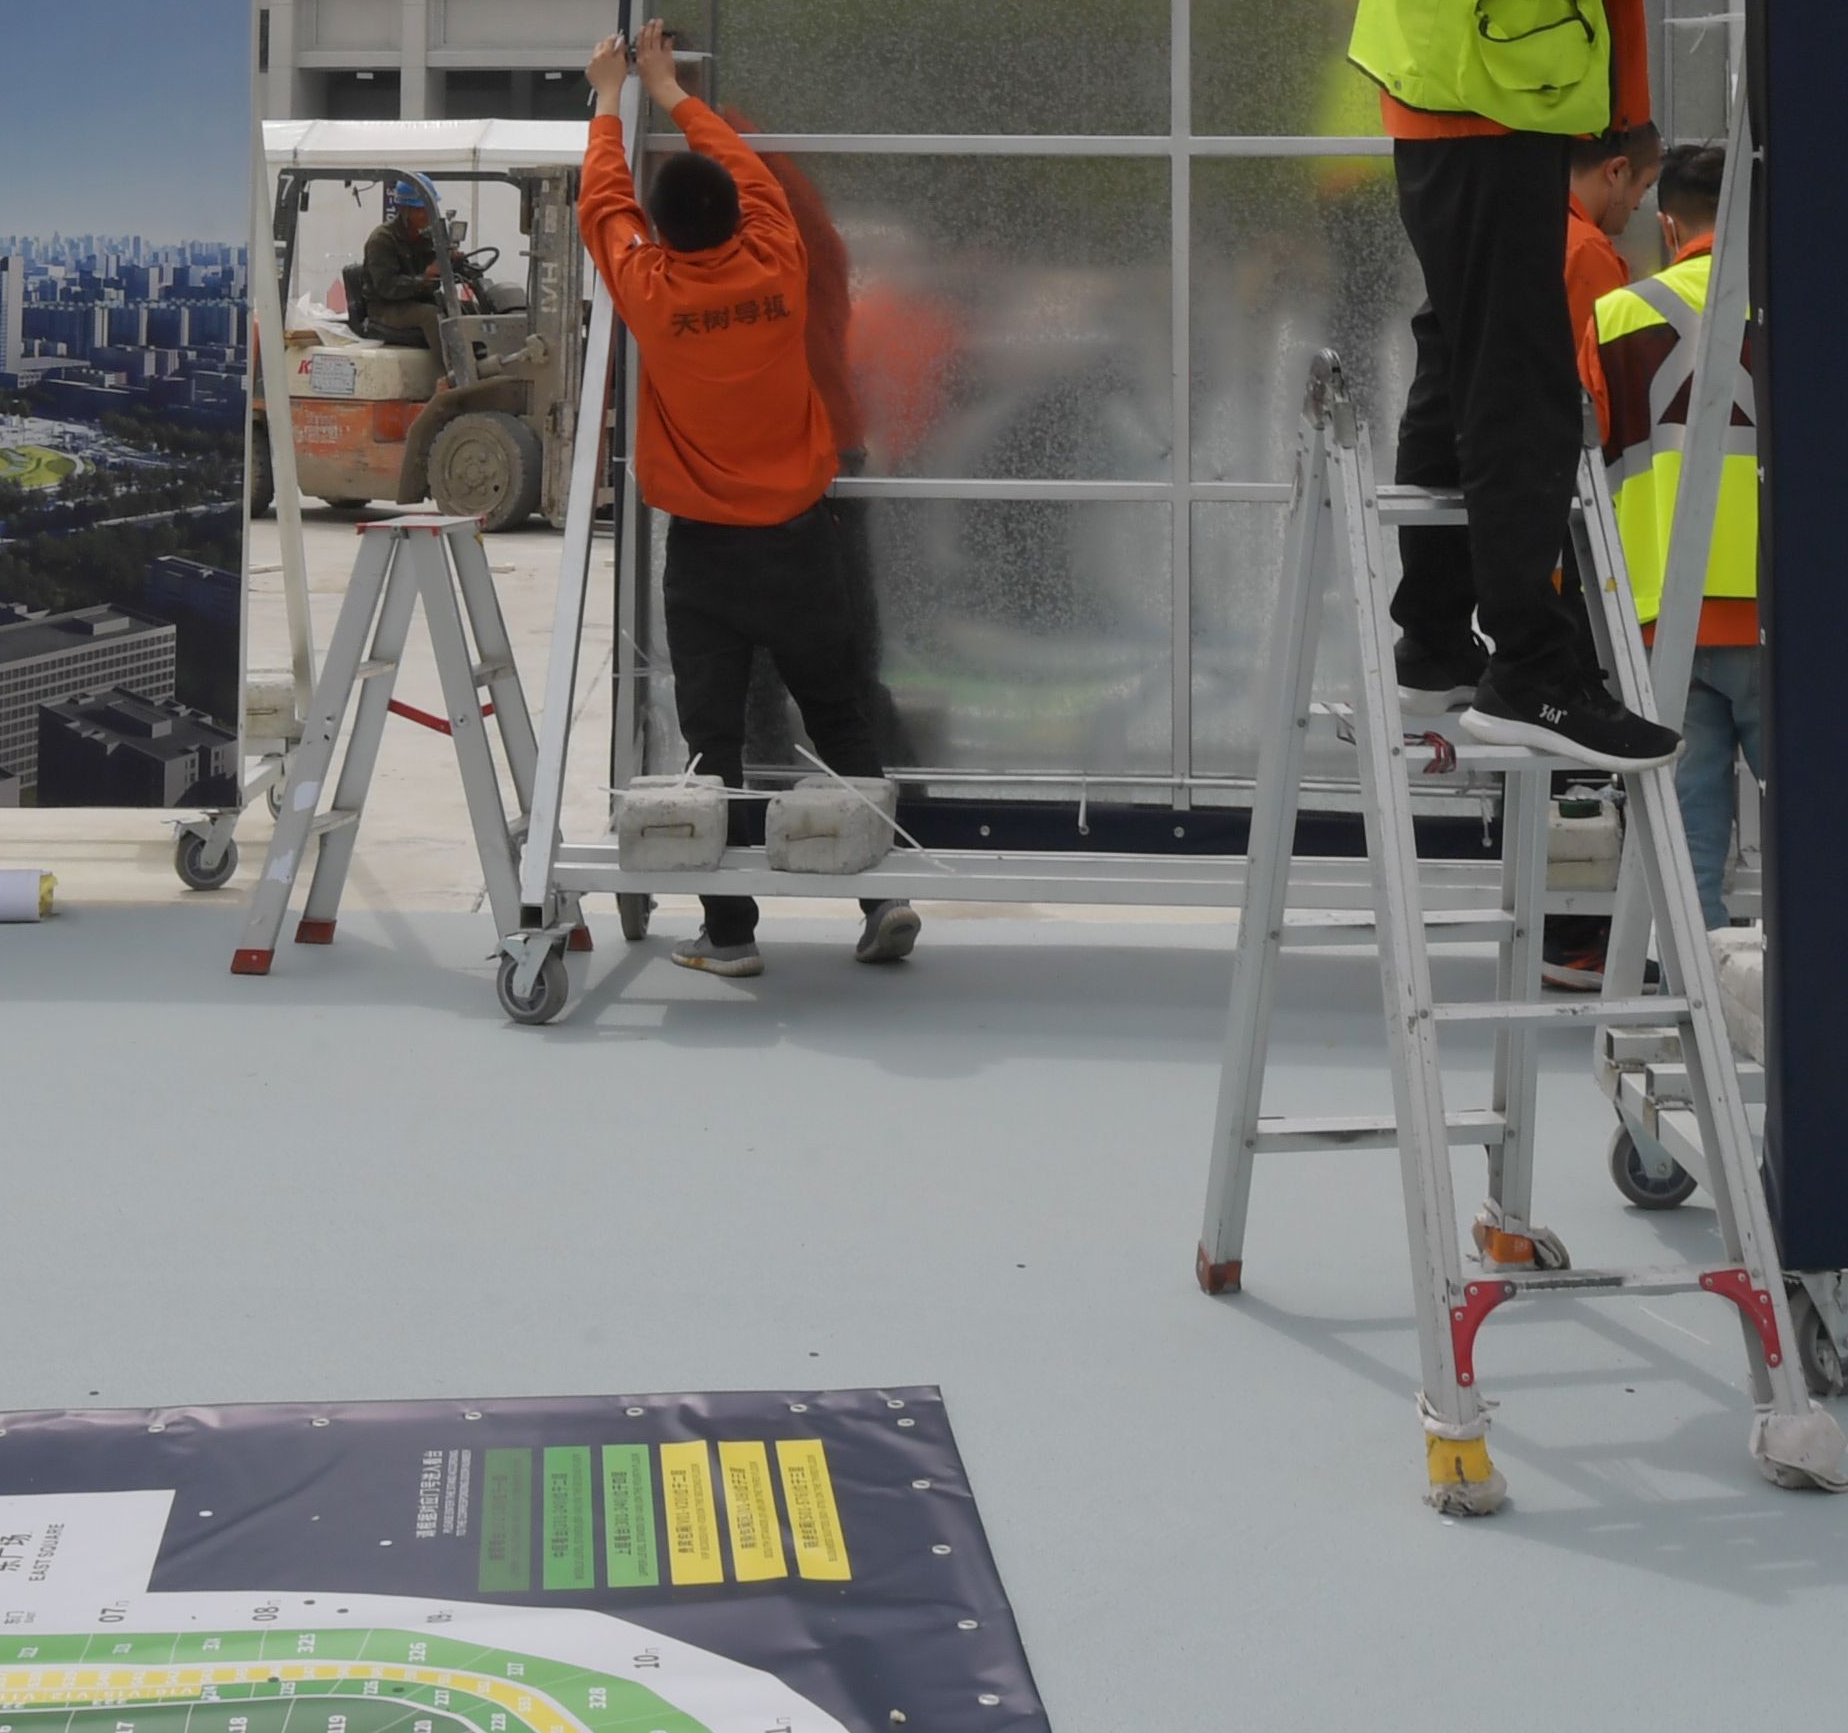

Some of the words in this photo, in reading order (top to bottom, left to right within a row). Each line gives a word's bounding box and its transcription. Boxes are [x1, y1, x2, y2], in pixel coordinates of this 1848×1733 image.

[38, 1523, 65, 1559] SQUARE
[28, 1559, 52, 1582] EAST
[298, 1634, 315, 1654] 325
[409, 1642, 427, 1663] 326
[589, 1687, 607, 1710] 328
